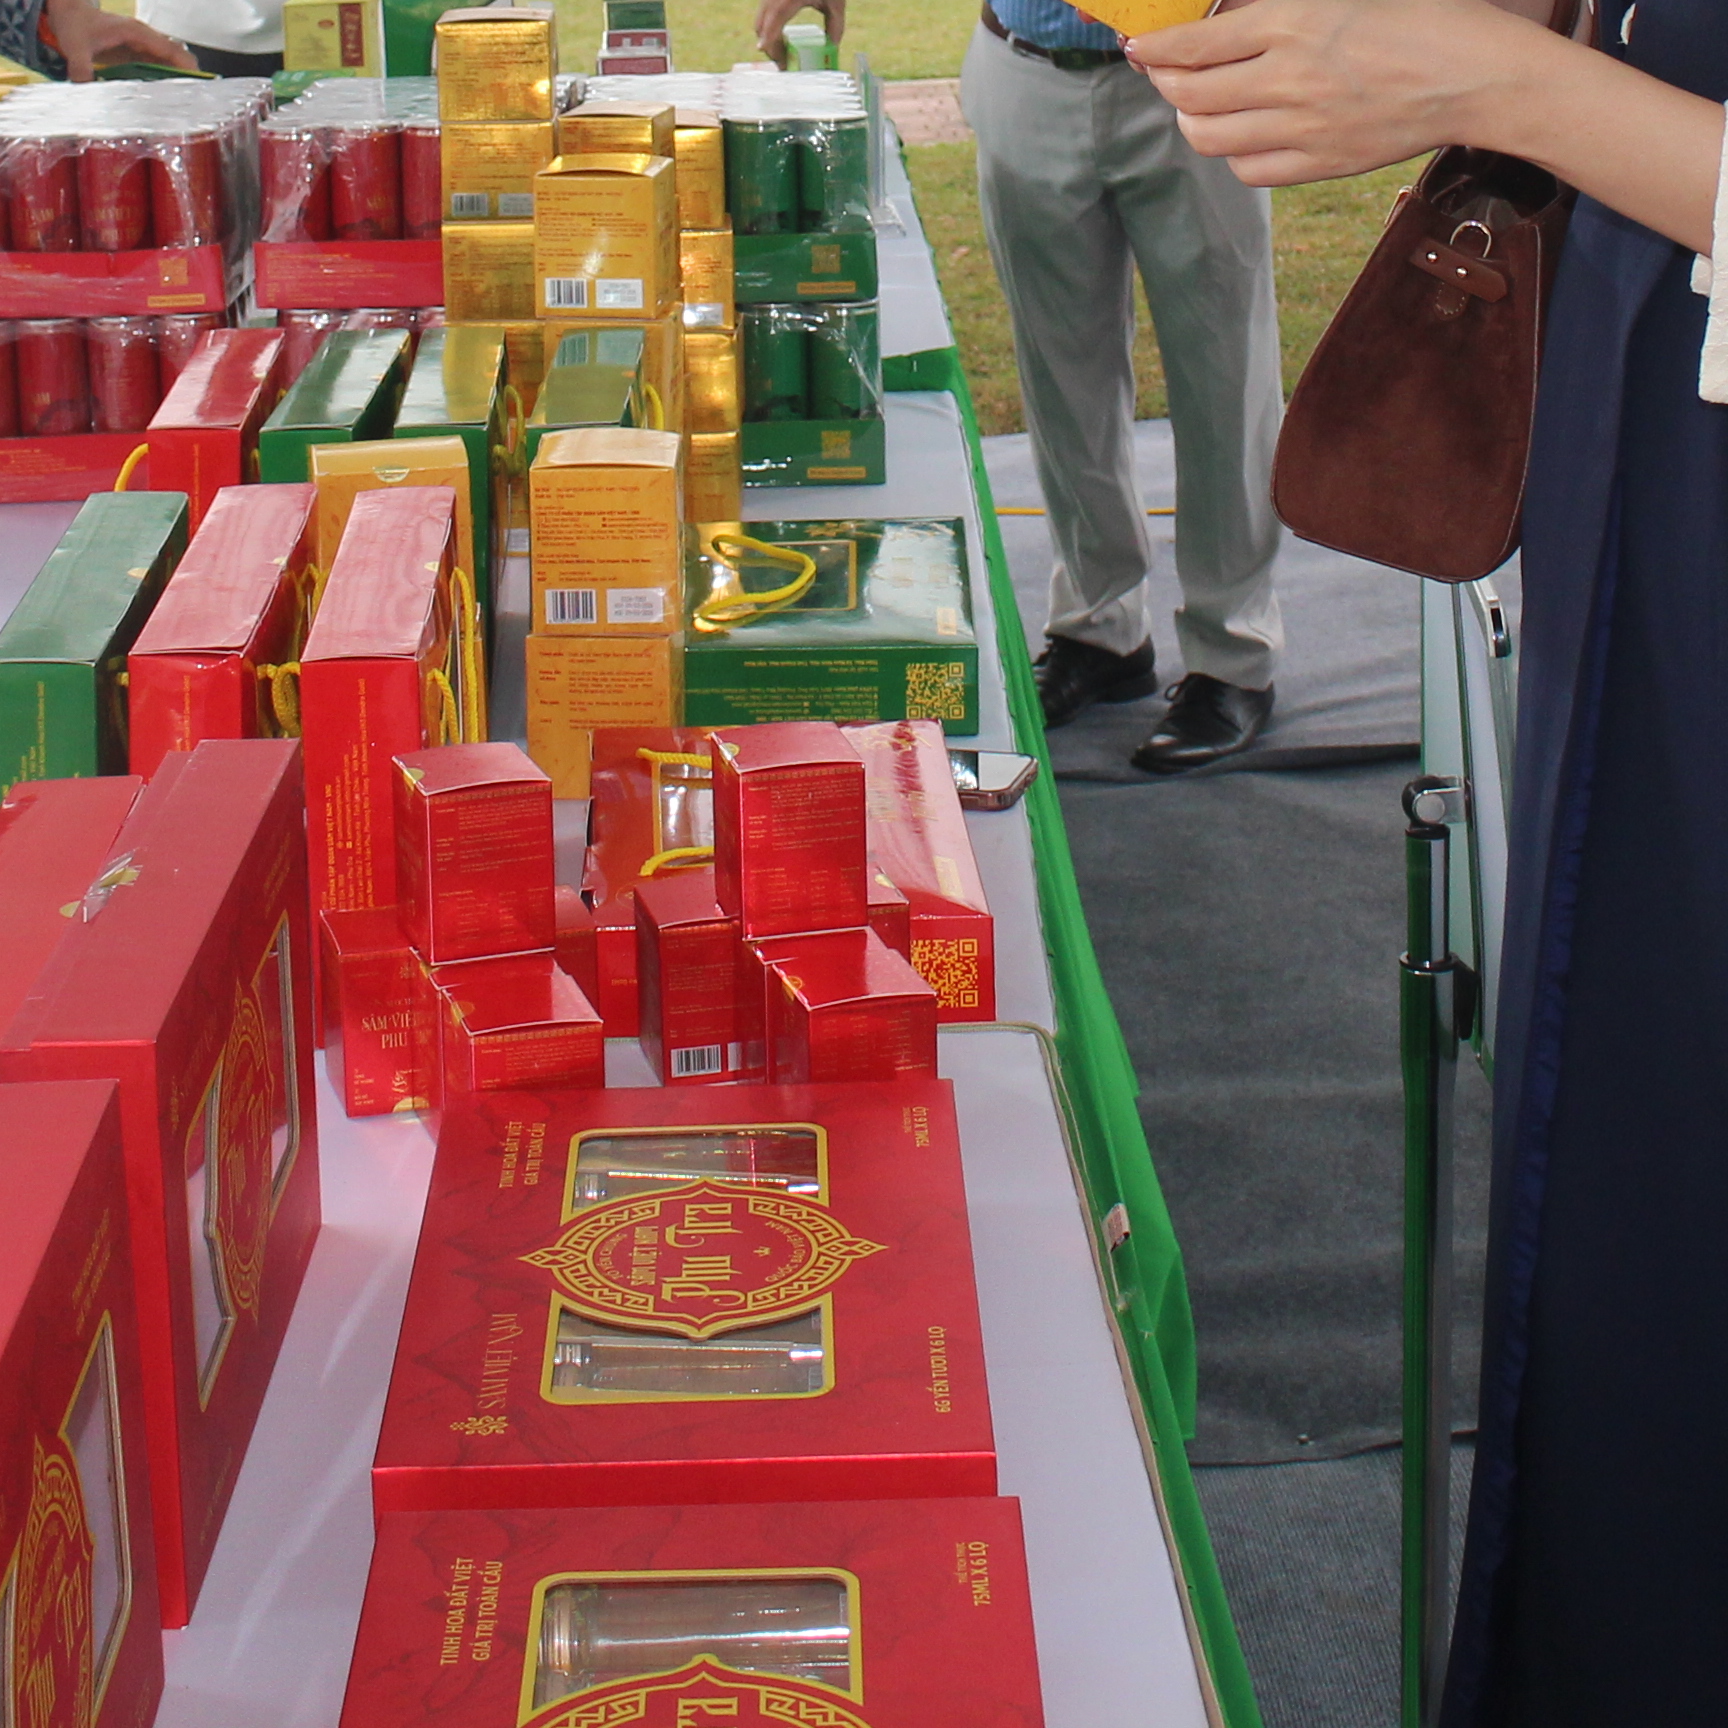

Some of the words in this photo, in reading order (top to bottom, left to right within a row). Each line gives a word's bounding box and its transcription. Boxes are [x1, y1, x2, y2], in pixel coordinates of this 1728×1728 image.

[487, 1313, 523, 1345] NAM
[483, 1349, 519, 1376] VIỆT
[477, 1377, 509, 1409] SÂM
[924, 1378, 950, 1399] YẾN
[934, 1399, 951, 1413] 6G
[968, 1541, 989, 1557] LỌ
[451, 1558, 476, 1584] VIỆT
[970, 1558, 987, 1566] 6
[970, 1566, 988, 1576] X
[444, 1584, 469, 1607] ĐẤT
[477, 1586, 499, 1618] TOÀN
[972, 1577, 991, 1606] 75ML
[444, 1609, 466, 1635] HOA
[475, 1619, 498, 1638] TRỊ
[440, 1637, 461, 1666] TINH
[469, 1639, 492, 1662] GIÁ
